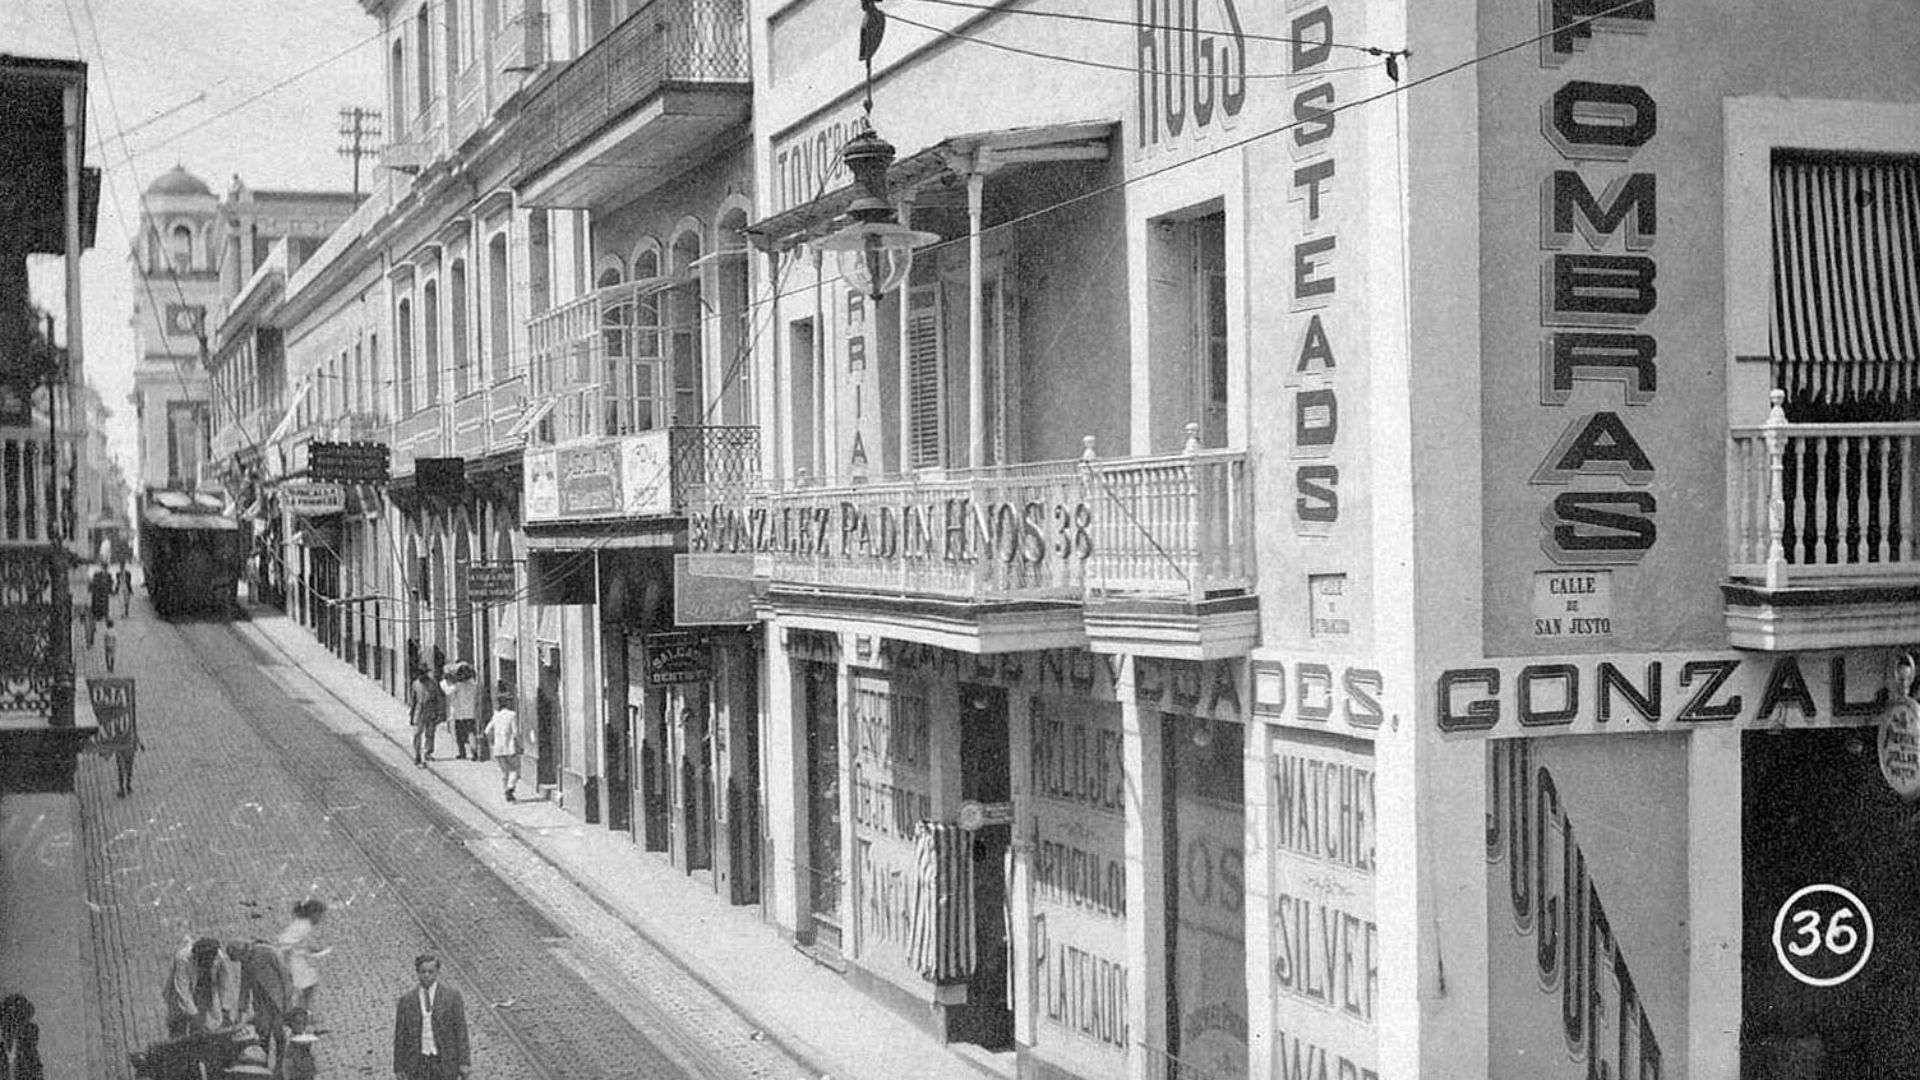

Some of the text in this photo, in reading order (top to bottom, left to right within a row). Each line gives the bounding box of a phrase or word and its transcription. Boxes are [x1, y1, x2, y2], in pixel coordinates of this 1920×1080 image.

[839, 500, 934, 561] PADIN
[1055, 502, 1094, 560] 38
[1550, 577, 1596, 594] CALLE
[1535, 617, 1612, 635] SAN JUSTO
[1437, 655, 1890, 731] GONZAL
